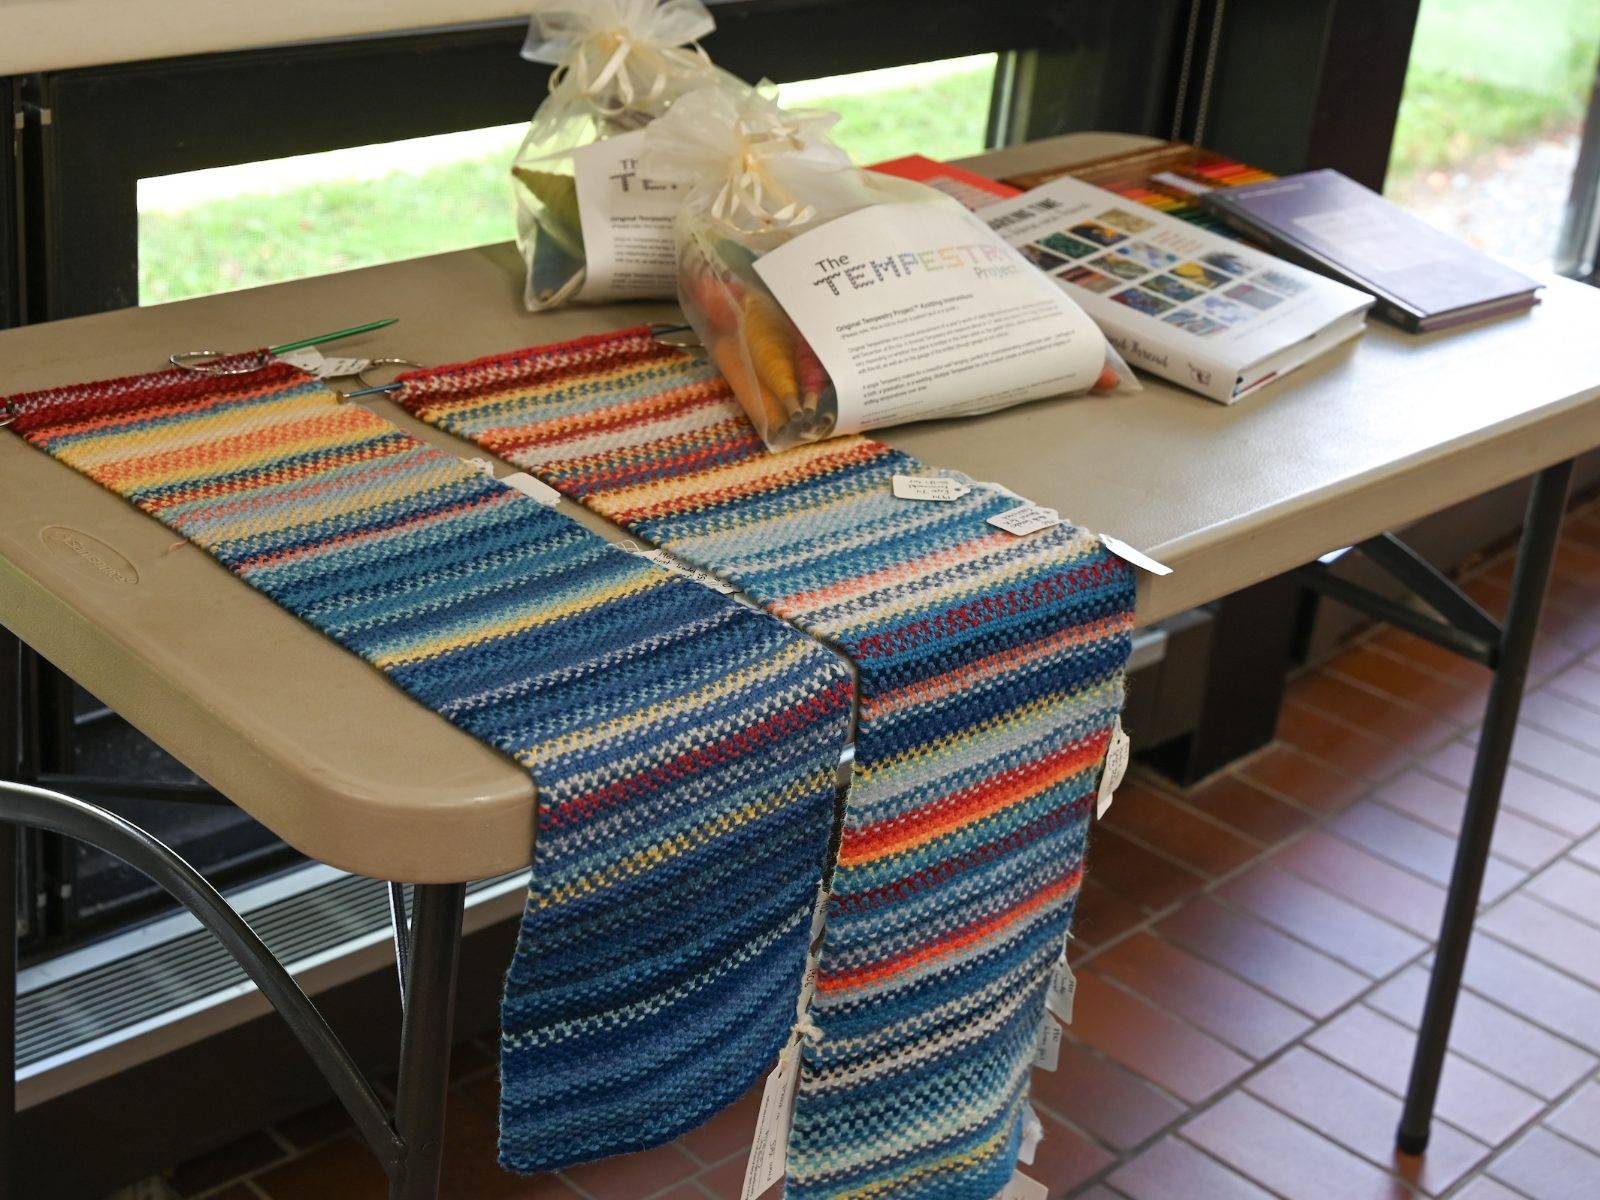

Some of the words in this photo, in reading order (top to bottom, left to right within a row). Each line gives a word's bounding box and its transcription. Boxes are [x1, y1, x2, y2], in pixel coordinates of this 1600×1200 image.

[813, 244, 1010, 297] TEMPESTR
[815, 254, 850, 273] The
[836, 320, 861, 332] Original
[862, 312, 892, 325] Tempestry
[920, 299, 942, 311] Knitting
